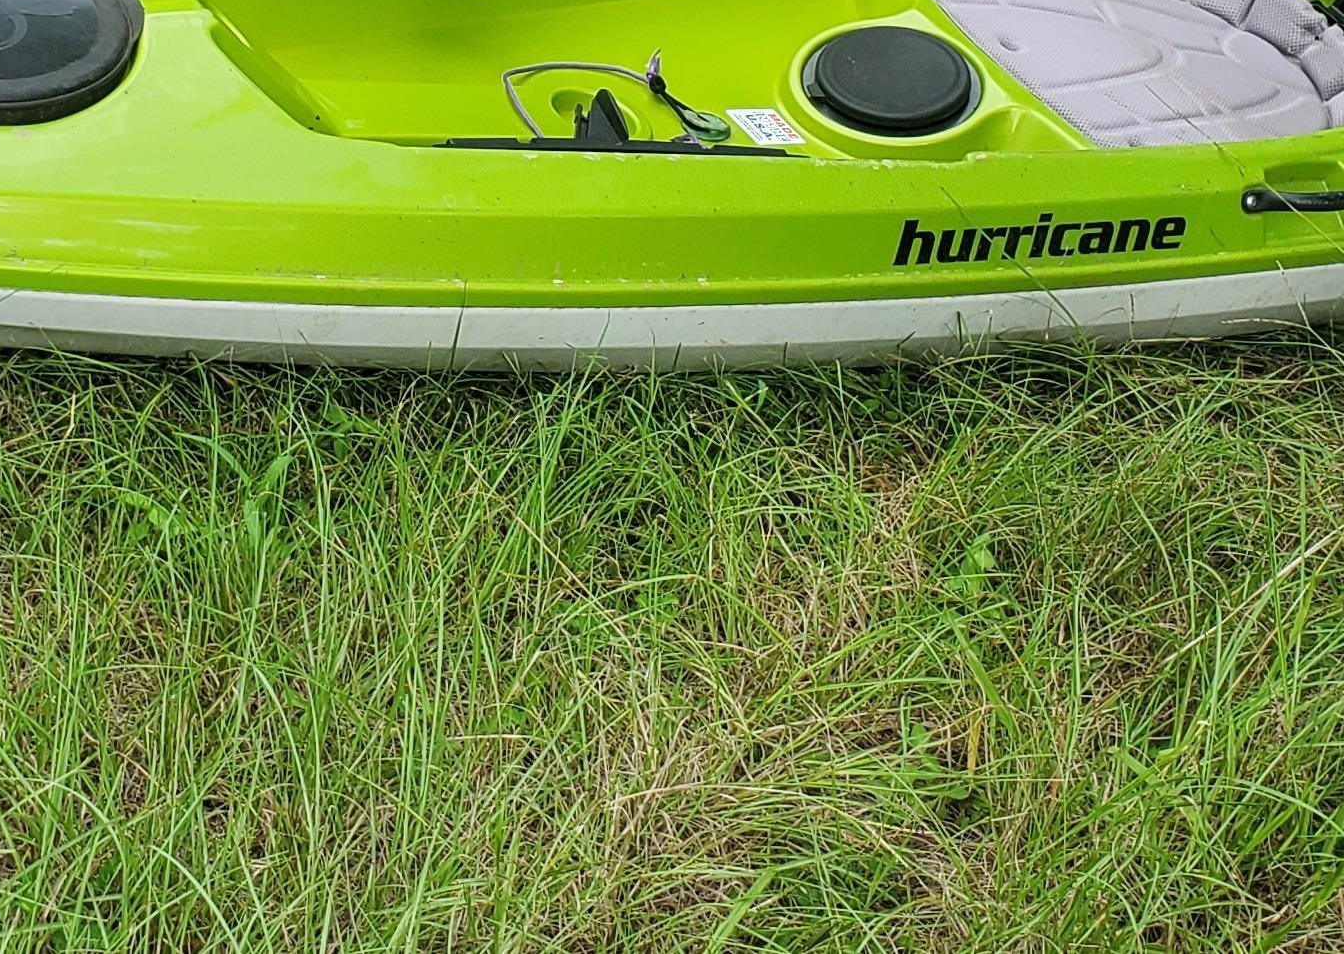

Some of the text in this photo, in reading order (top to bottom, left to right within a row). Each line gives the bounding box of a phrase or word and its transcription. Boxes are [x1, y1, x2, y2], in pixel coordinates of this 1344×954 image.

[745, 114, 773, 140] U.S.A.
[767, 113, 799, 139] MADE
[892, 212, 1187, 267] hurricane
